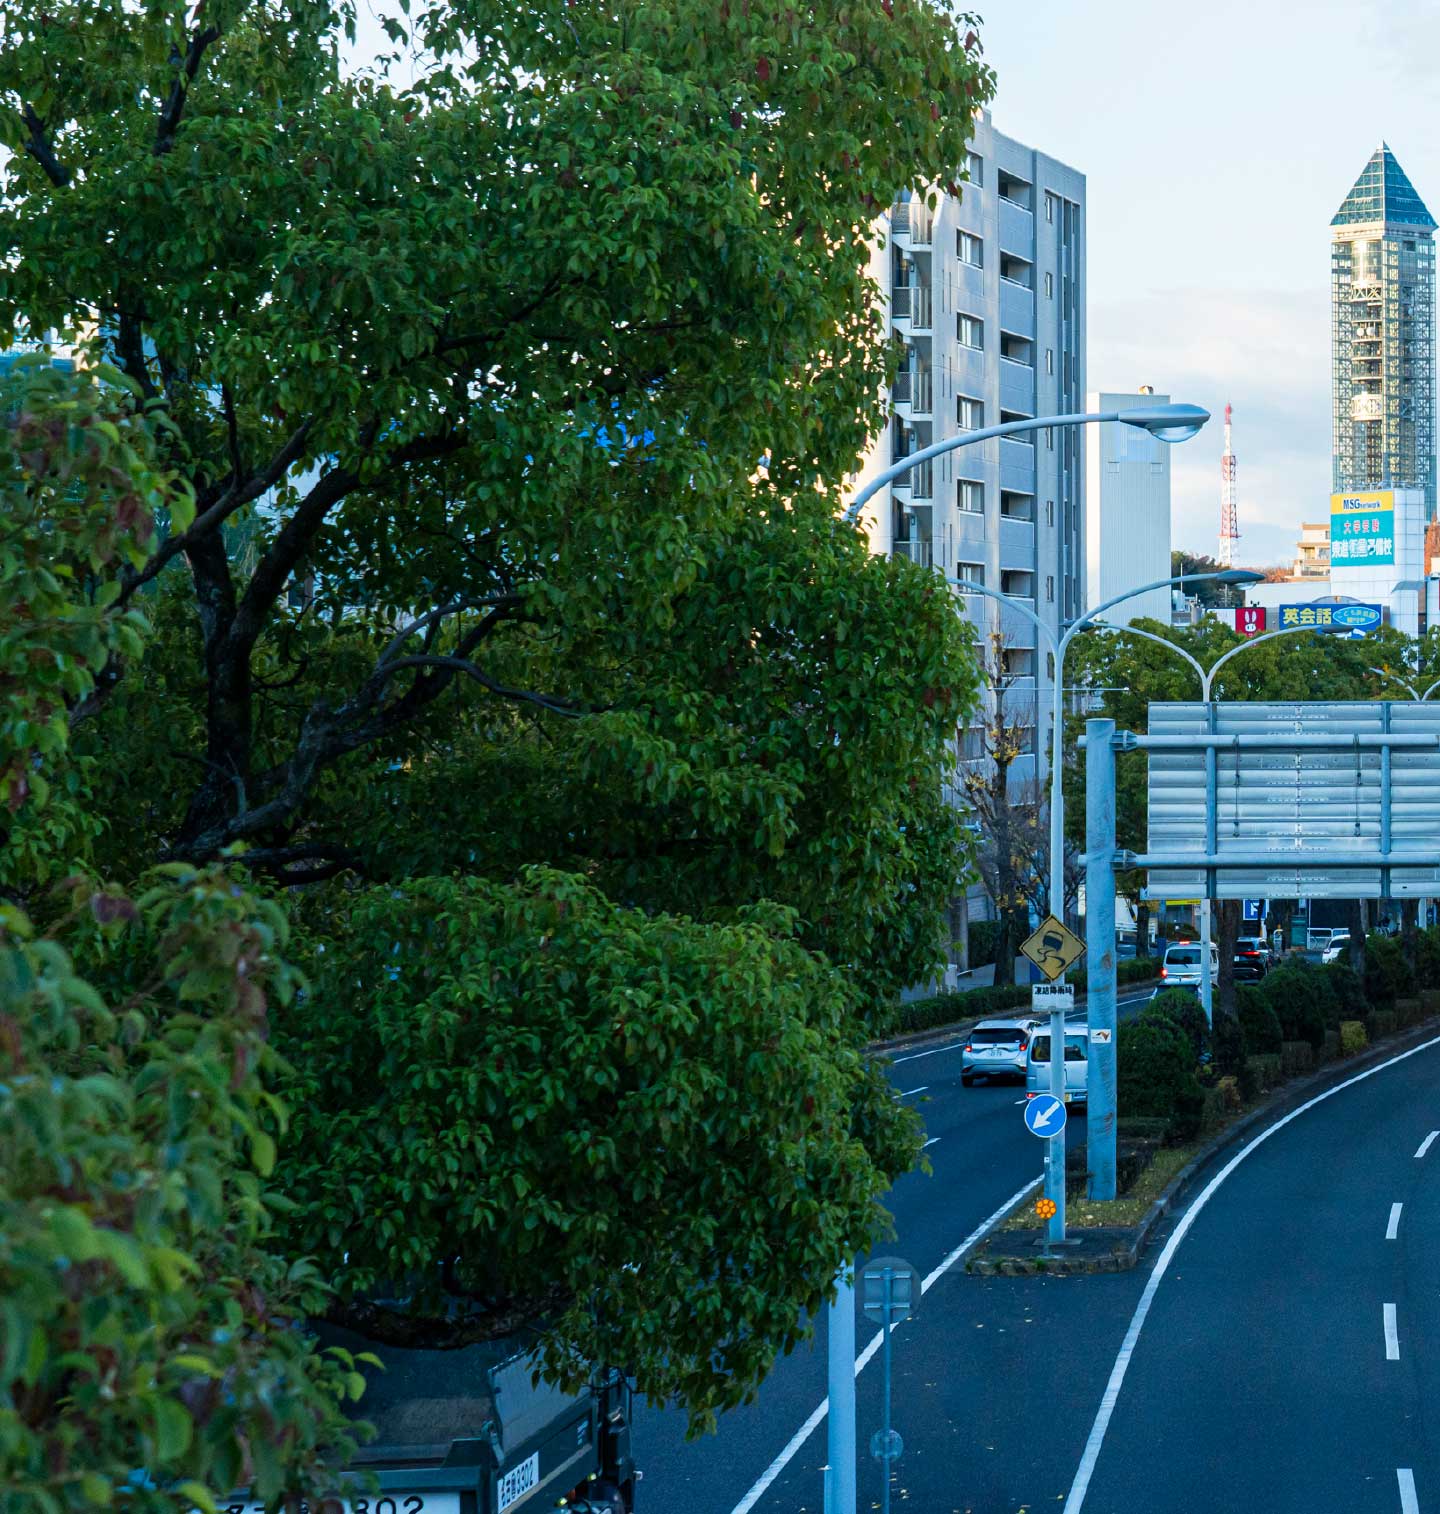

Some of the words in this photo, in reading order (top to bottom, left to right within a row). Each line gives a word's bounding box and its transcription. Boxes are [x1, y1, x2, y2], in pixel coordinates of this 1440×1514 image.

[1343, 518, 1380, 534] 大学受験
[1283, 607, 1332, 625] 英会話
